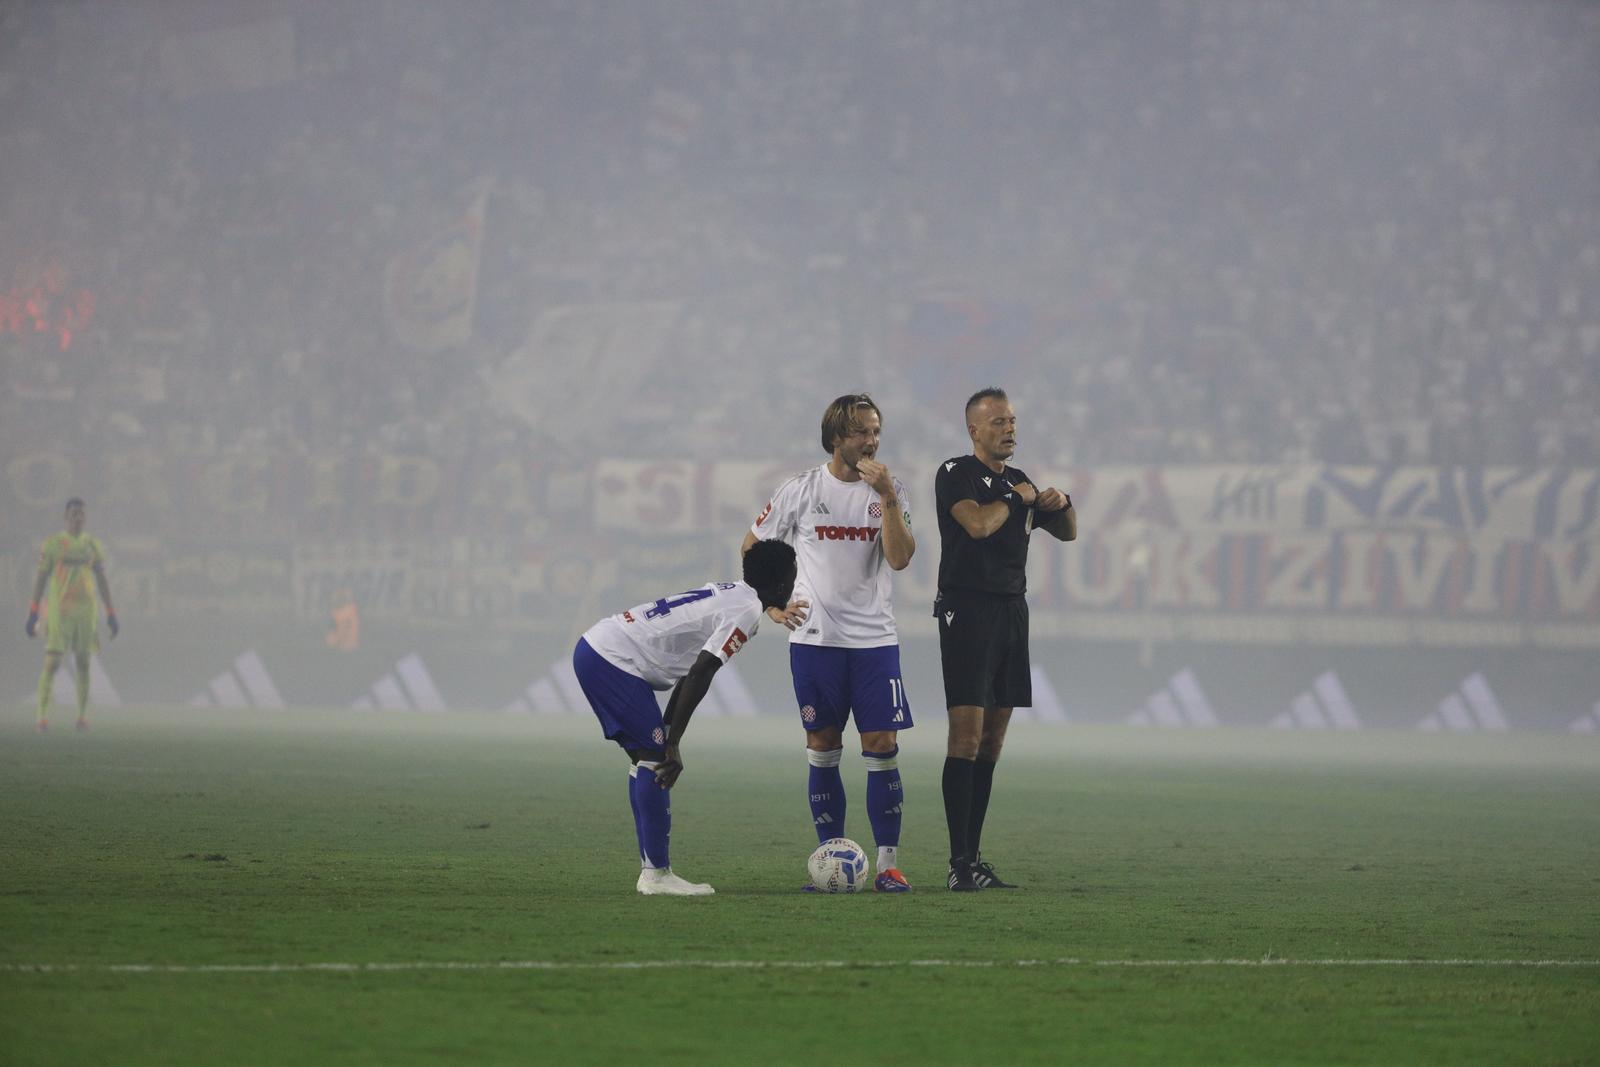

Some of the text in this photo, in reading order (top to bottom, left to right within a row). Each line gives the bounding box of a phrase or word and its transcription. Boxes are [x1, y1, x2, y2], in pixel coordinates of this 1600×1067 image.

[815, 526, 880, 542] TOMMY
[889, 679, 903, 708] 11
[811, 793, 830, 802] 1911
